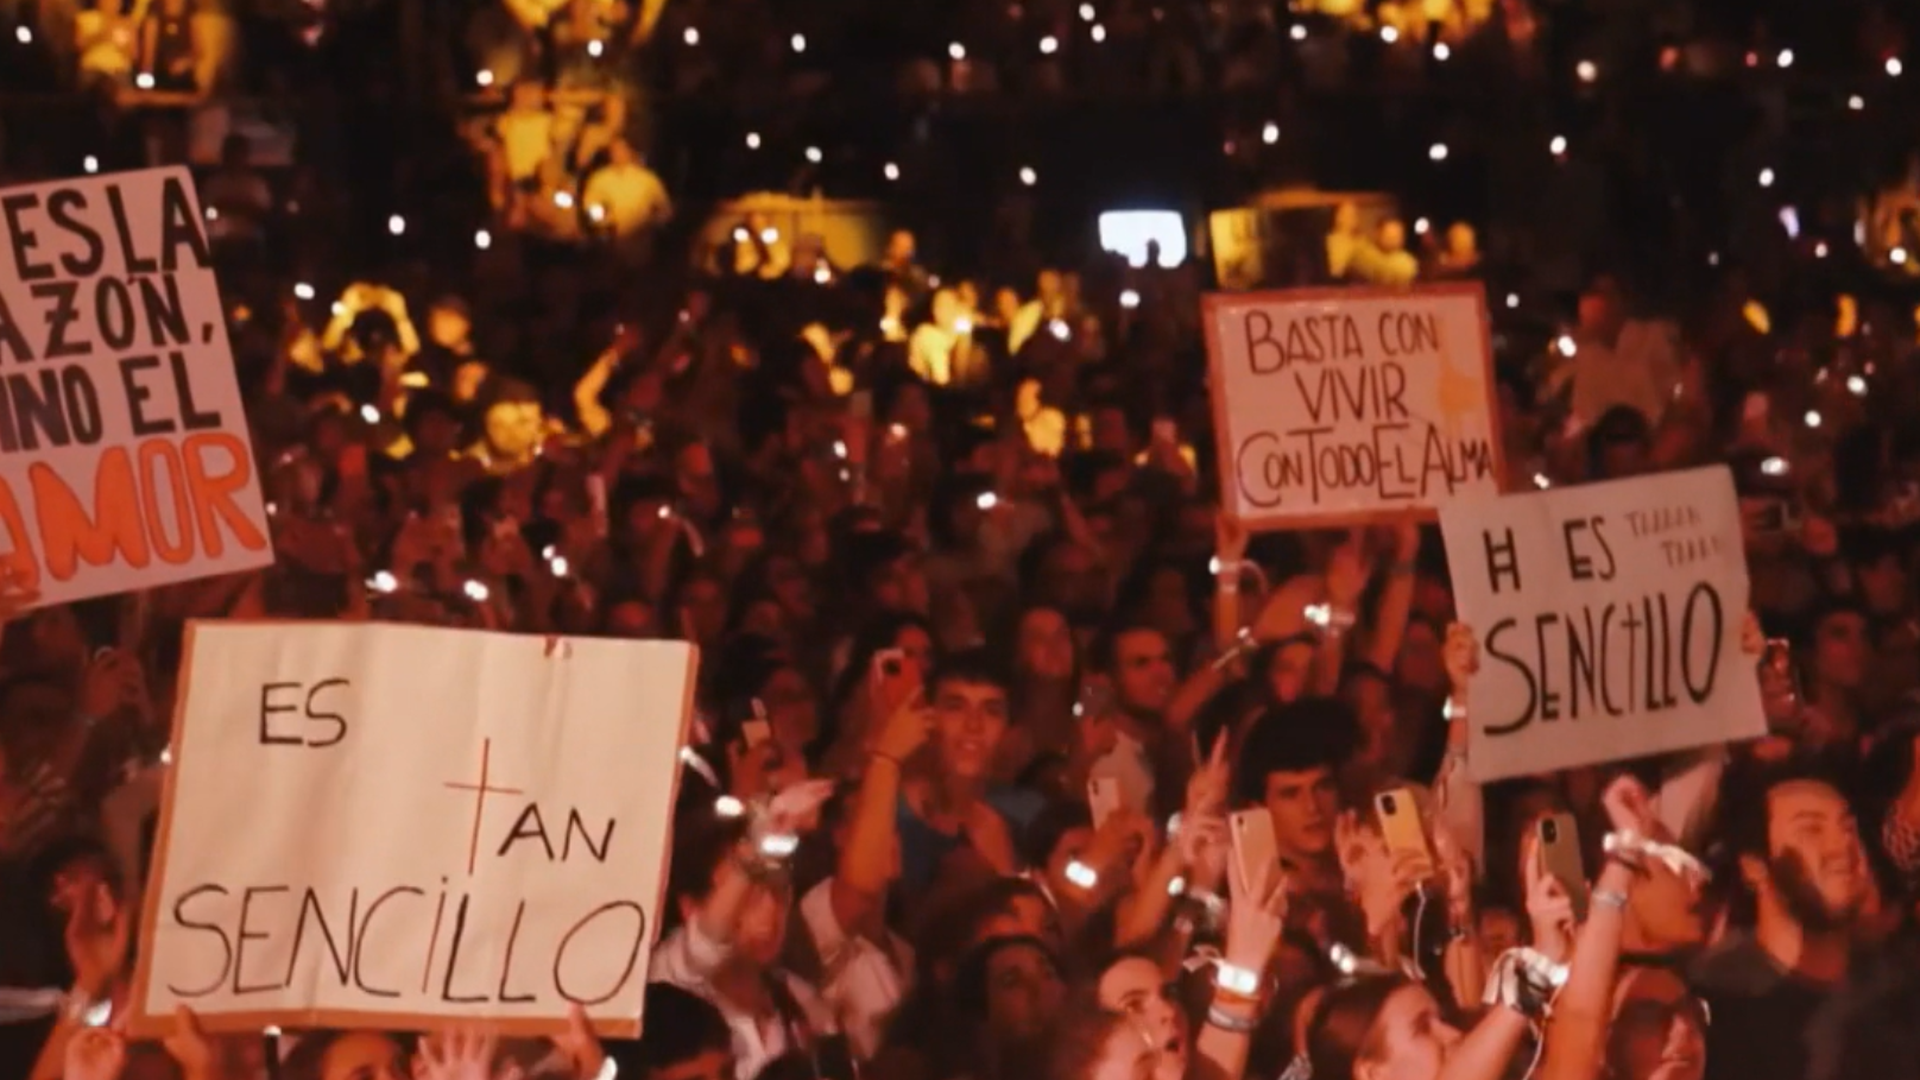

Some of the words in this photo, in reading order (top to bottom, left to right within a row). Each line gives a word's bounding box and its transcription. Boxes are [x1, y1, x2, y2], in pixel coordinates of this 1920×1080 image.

[4, 188, 105, 281] ES
[105, 176, 212, 274] LA
[1244, 309, 1363, 375] BASTA
[1378, 311, 1439, 356] CON
[118, 350, 222, 436] EL
[1294, 361, 1409, 423] VIVIR
[1563, 515, 1616, 581] ES
[259, 678, 351, 748] ES
